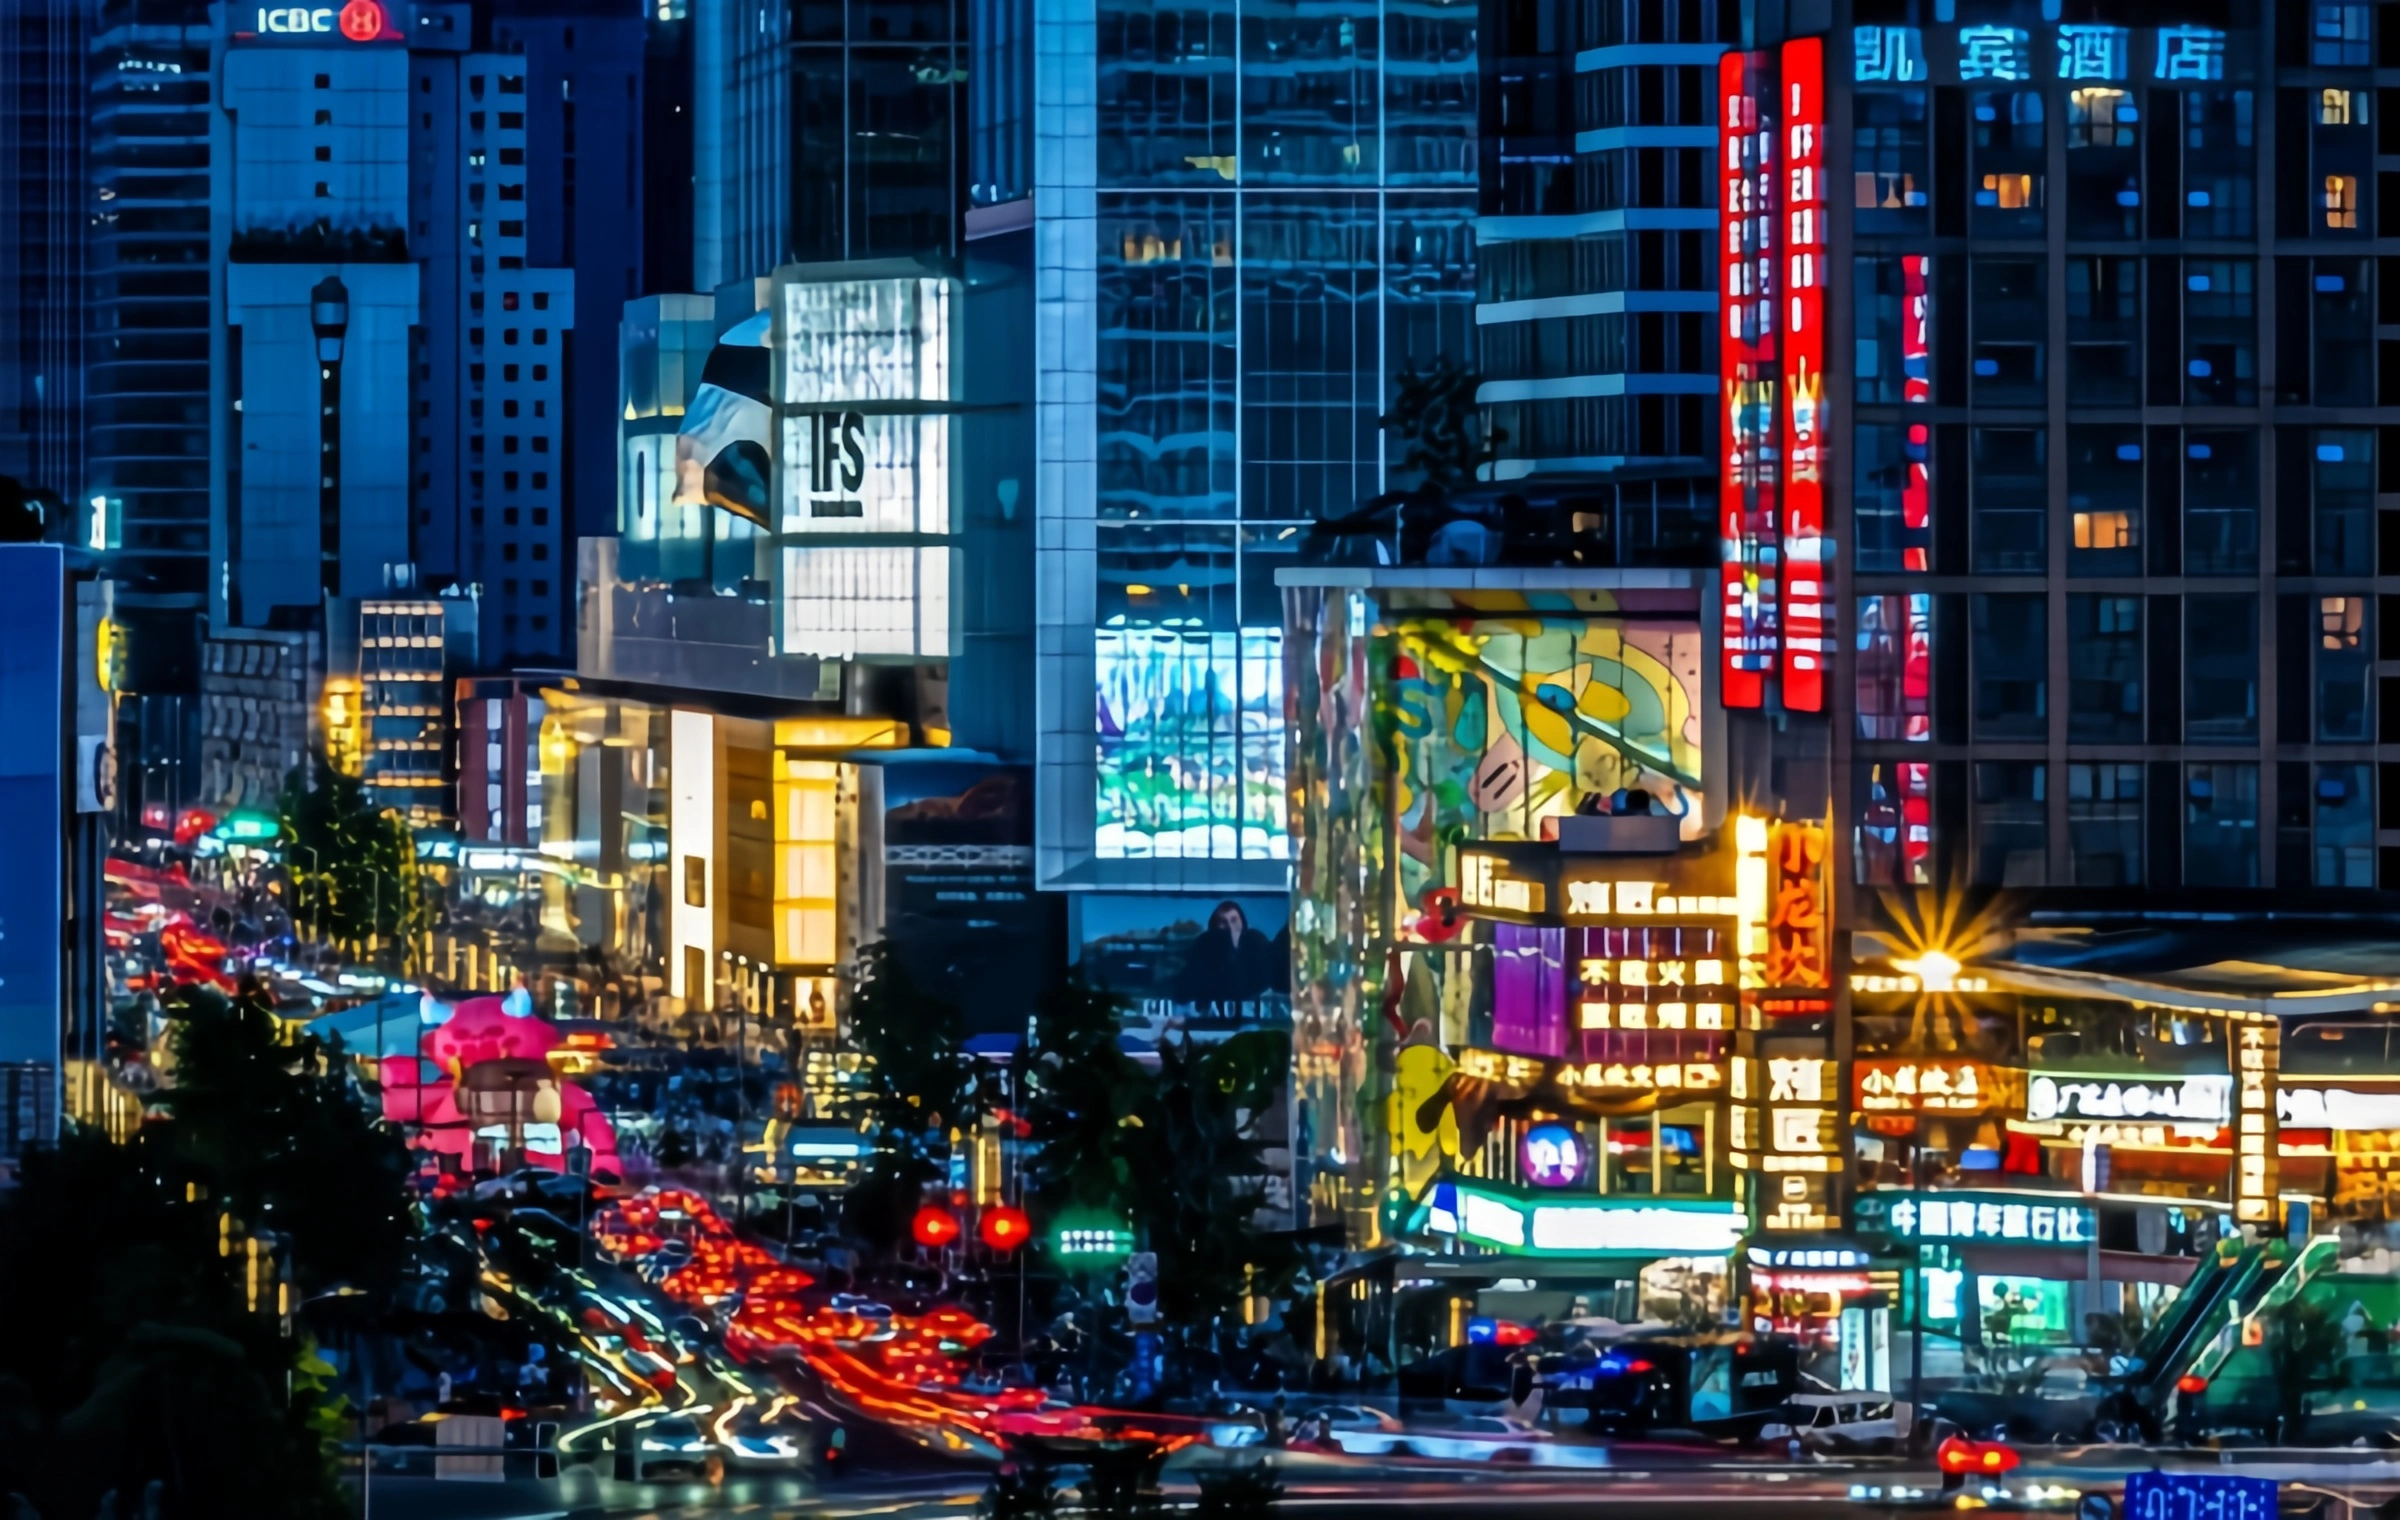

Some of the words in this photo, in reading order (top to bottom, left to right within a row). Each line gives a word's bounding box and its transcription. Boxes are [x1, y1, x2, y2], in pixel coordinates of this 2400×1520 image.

[258, 8, 332, 33] ICBC
[1854, 23, 2222, 81] 凯宾酒店
[811, 411, 866, 494] IFS
